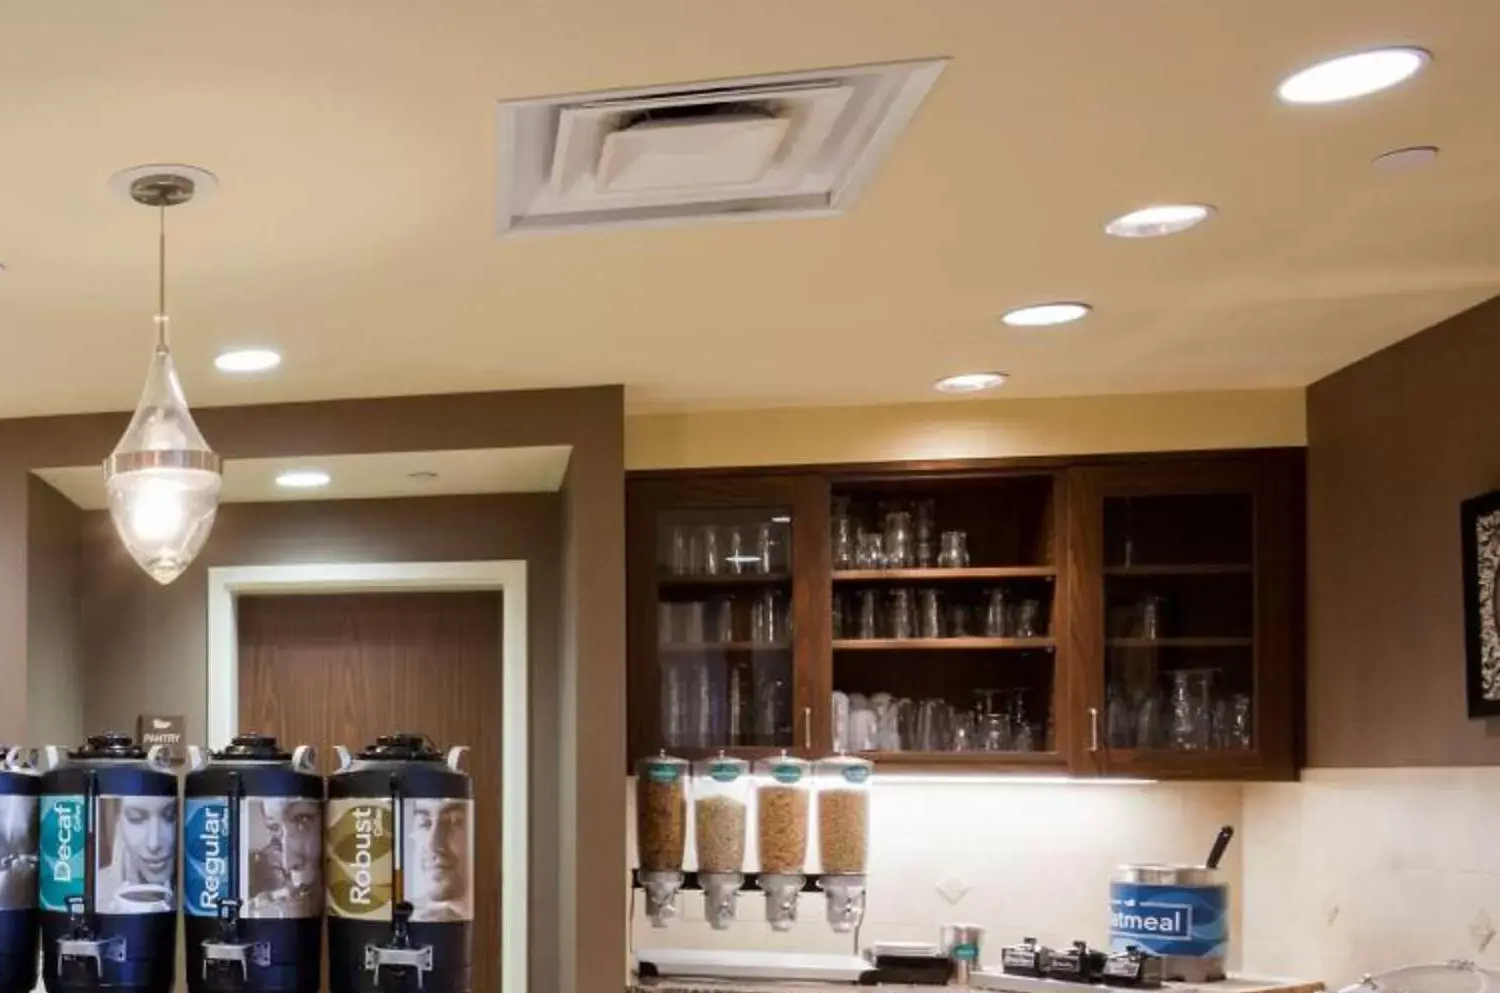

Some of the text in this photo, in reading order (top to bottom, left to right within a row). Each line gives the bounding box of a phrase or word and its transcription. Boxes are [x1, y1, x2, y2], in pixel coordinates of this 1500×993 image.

[143, 733, 180, 744] PANTRY
[52, 800, 71, 881] Decaf
[200, 807, 225, 909] Regular
[349, 807, 371, 905] Robust
[1110, 911, 1180, 932] atmeal
